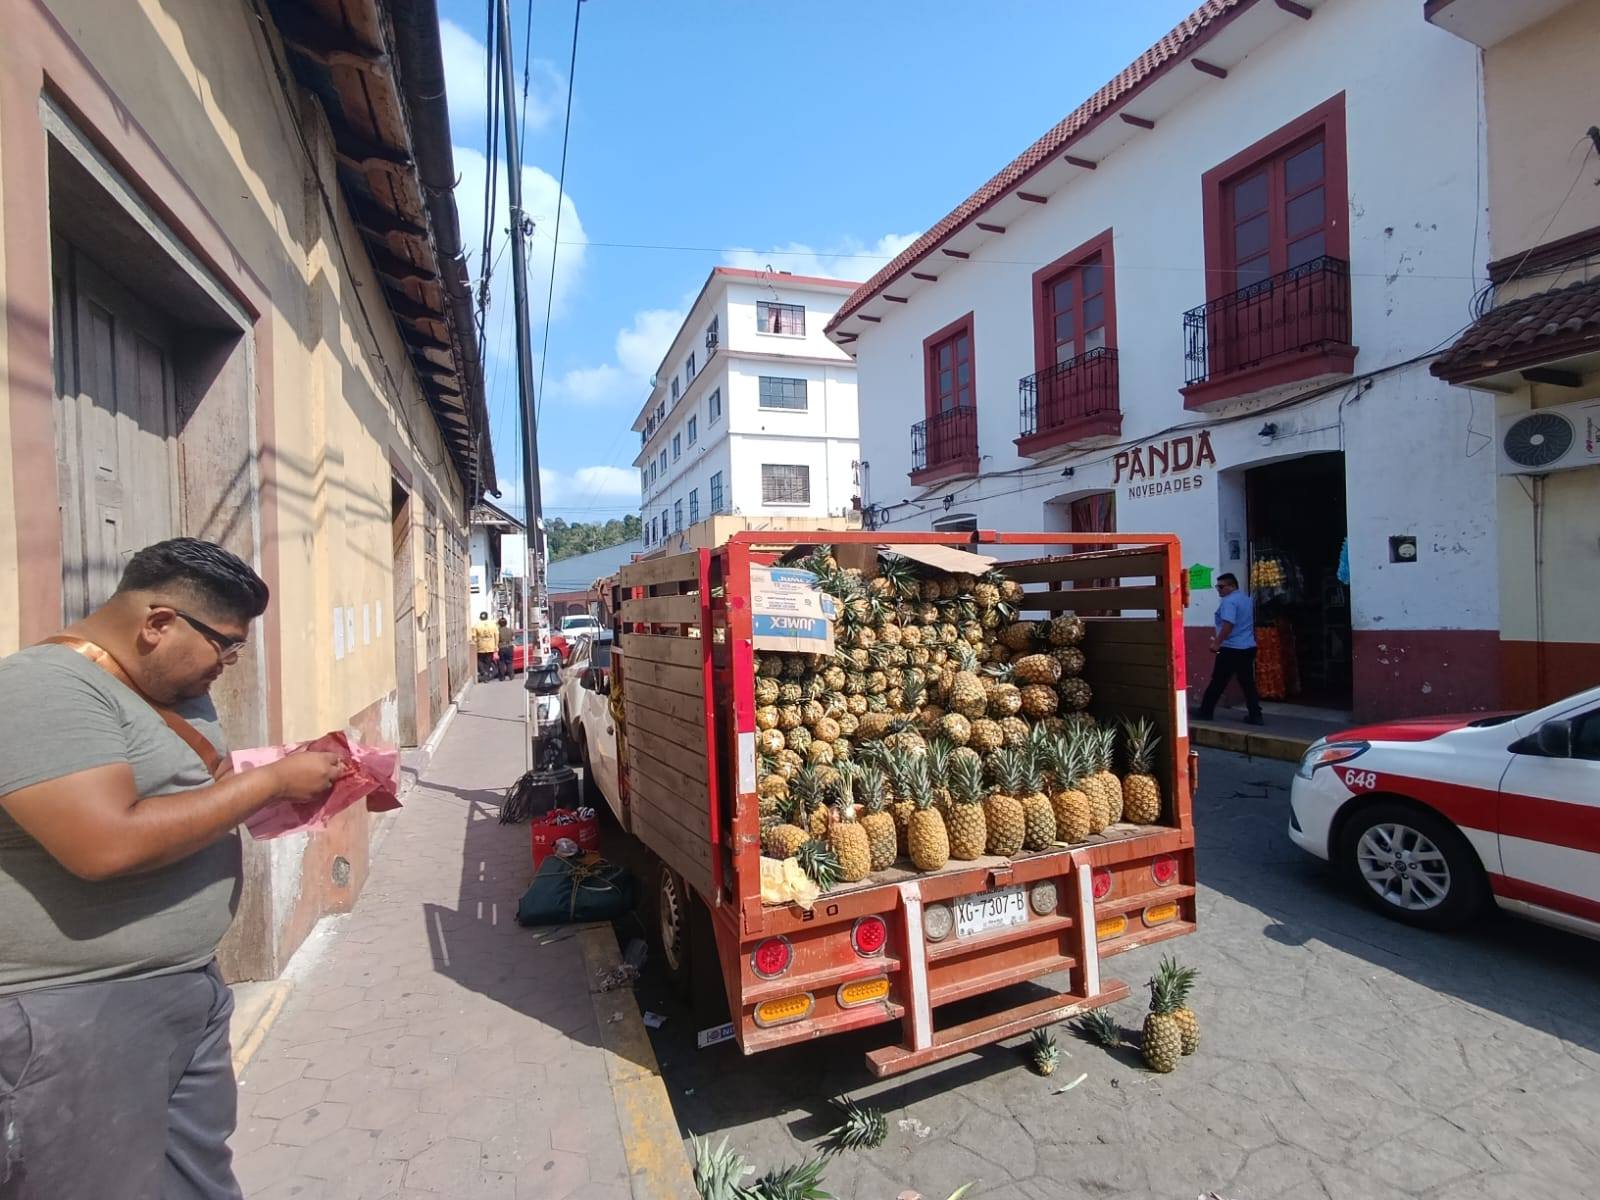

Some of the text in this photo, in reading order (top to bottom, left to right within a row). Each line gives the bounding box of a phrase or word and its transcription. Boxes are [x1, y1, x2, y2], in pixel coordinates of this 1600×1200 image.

[1113, 429, 1217, 485] PANDA
[1128, 474, 1203, 499] NOVEDADES
[769, 616, 816, 632] JUMEX
[1344, 769, 1377, 790] 648
[957, 891, 1025, 925] XG-7307-B
